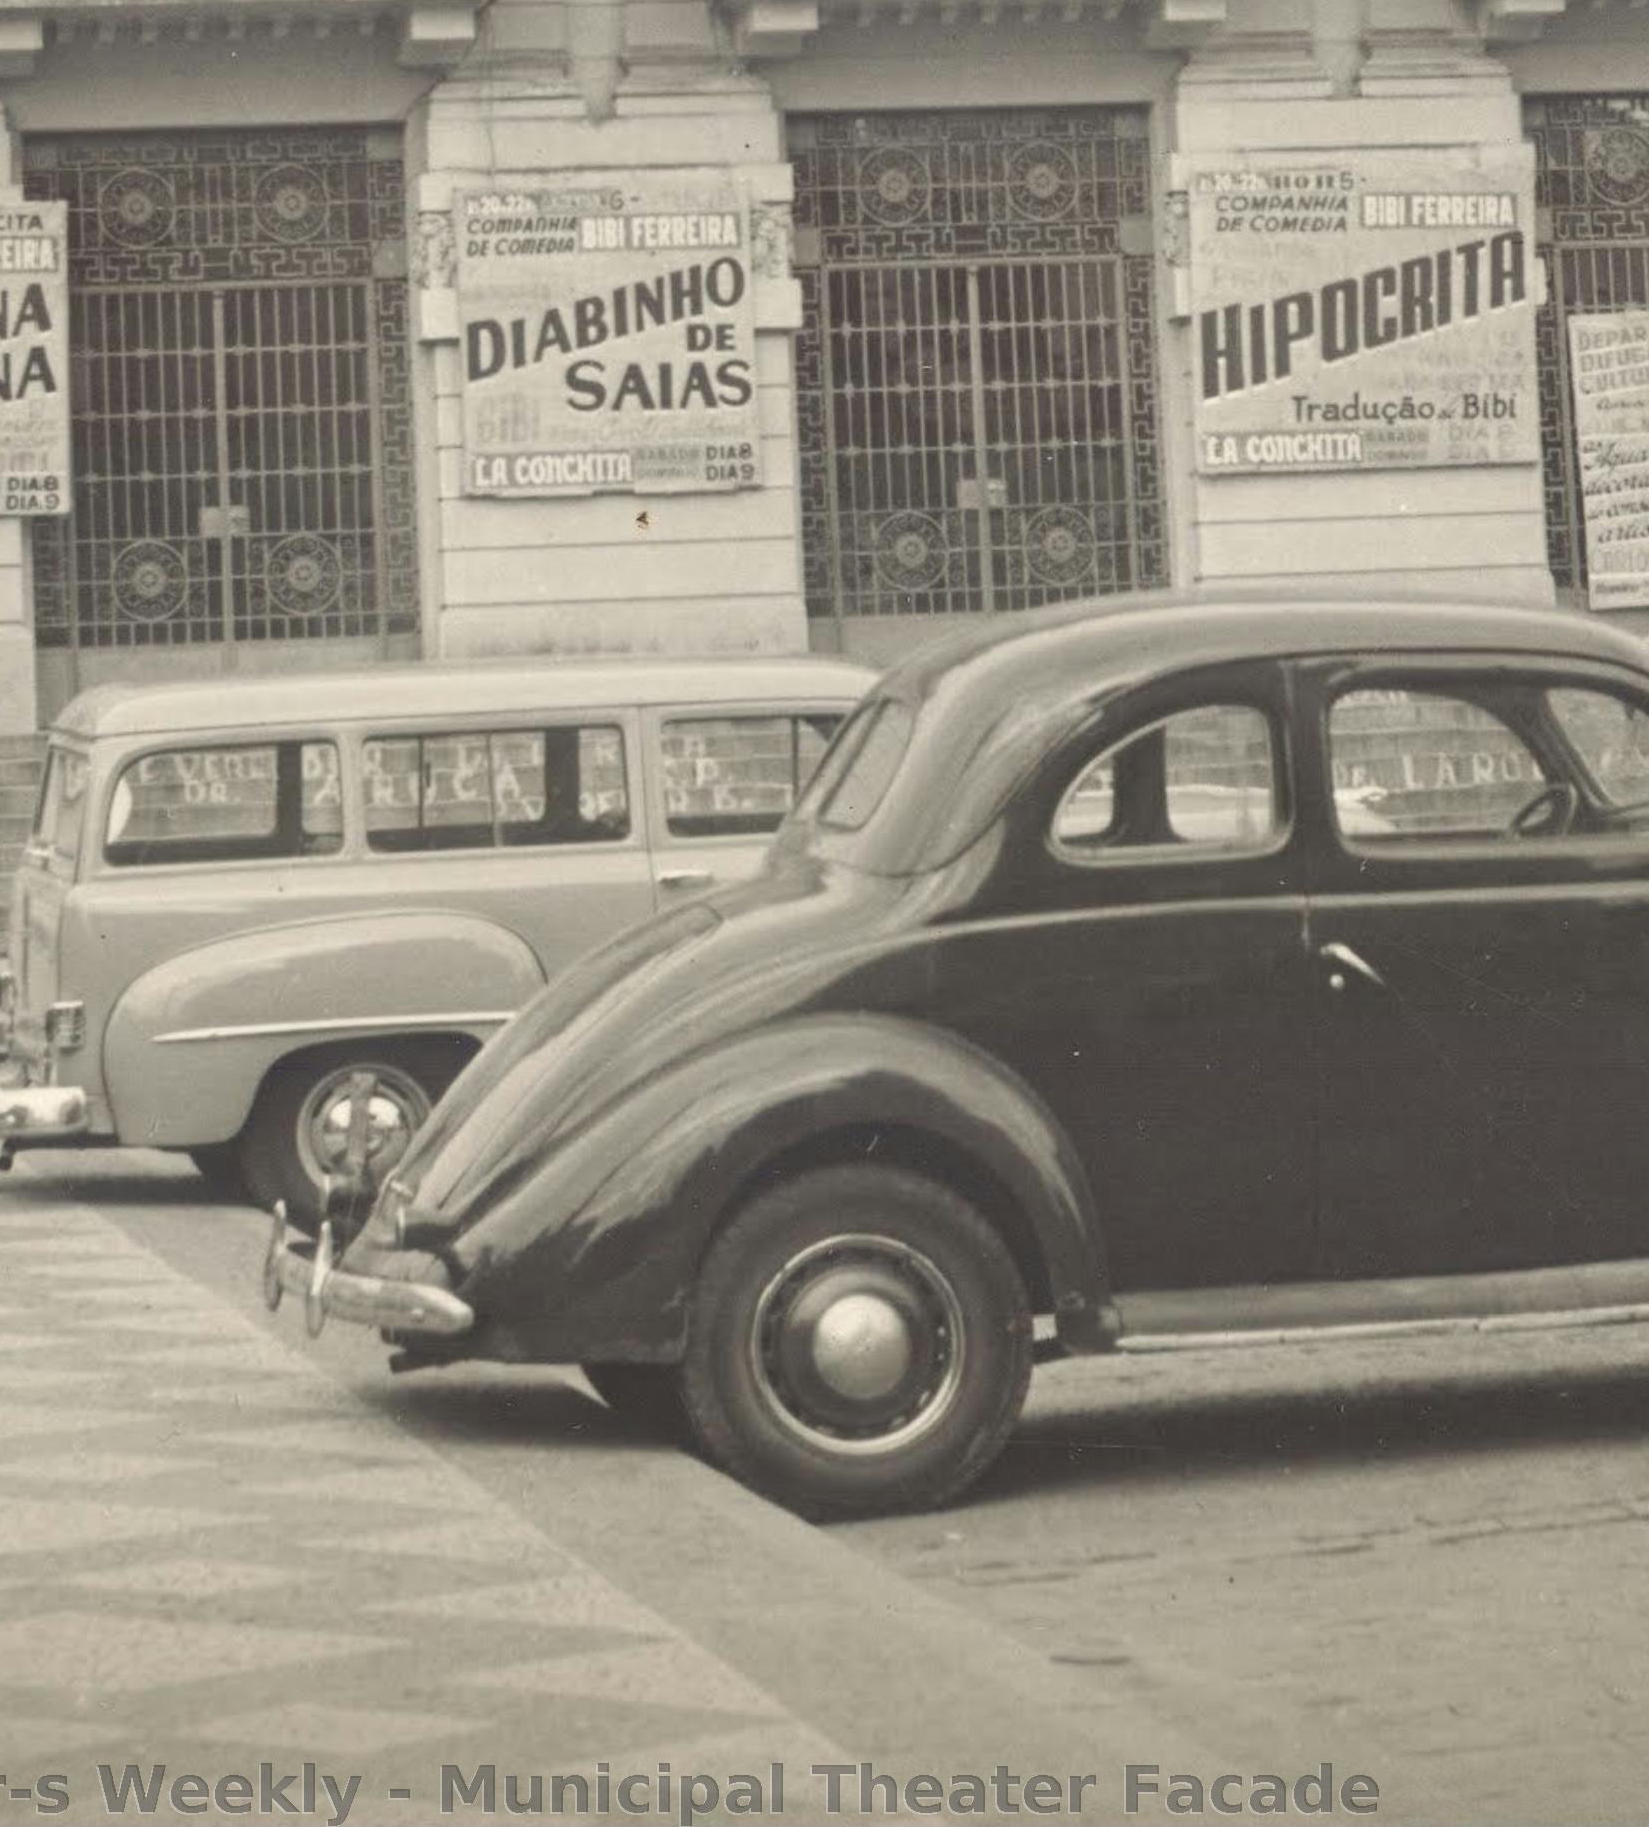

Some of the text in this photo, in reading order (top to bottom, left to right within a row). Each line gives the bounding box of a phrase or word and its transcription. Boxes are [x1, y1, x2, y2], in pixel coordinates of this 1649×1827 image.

[1215, 194, 1515, 225] COMPANHIA BIBI FERREIRA
[1216, 216, 1242, 232] DE
[466, 214, 738, 249] COMPANHIA BIBI FERREIRA
[467, 237, 487, 257] DE
[466, 257, 745, 382] DIABINHO
[1200, 230, 1526, 400] HIPOCRITA
[686, 323, 737, 352] DE
[565, 359, 752, 412] SAIAS
[1291, 392, 1436, 424] Tradução
[1462, 392, 1518, 420] Bibi
[1206, 436, 1238, 465] LA
[1245, 432, 1362, 463] CONCHITA
[475, 457, 509, 487] LA
[514, 453, 633, 484] CONCHITA
